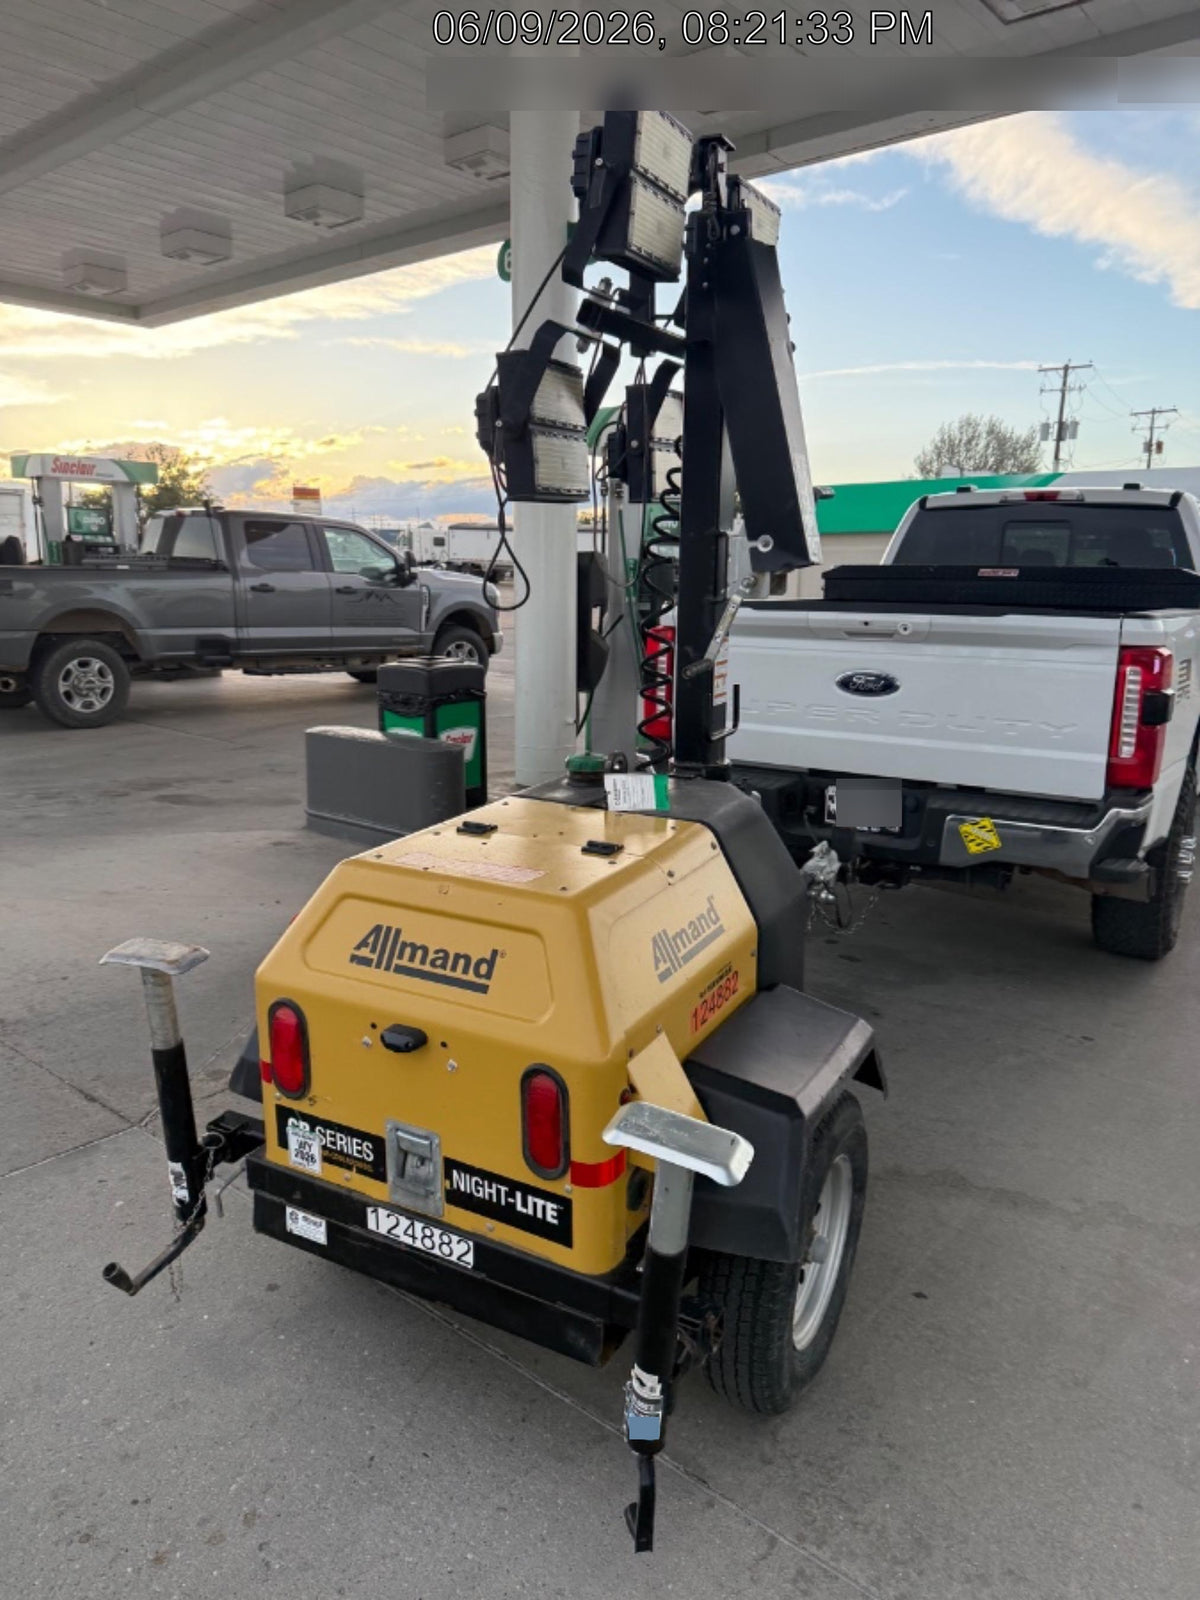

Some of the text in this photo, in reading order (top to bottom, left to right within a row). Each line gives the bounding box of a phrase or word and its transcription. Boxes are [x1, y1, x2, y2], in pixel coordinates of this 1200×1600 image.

[51, 457, 96, 476] Sinclair
[899, 709, 1079, 739] DUTY
[351, 923, 499, 982] Allmand
[652, 895, 722, 975] Allmand
[692, 969, 740, 1032] 124882
[314, 1125, 375, 1163] SERIES
[451, 1168, 559, 1226] NIGHT-LITE
[370, 1207, 473, 1267] 124882
